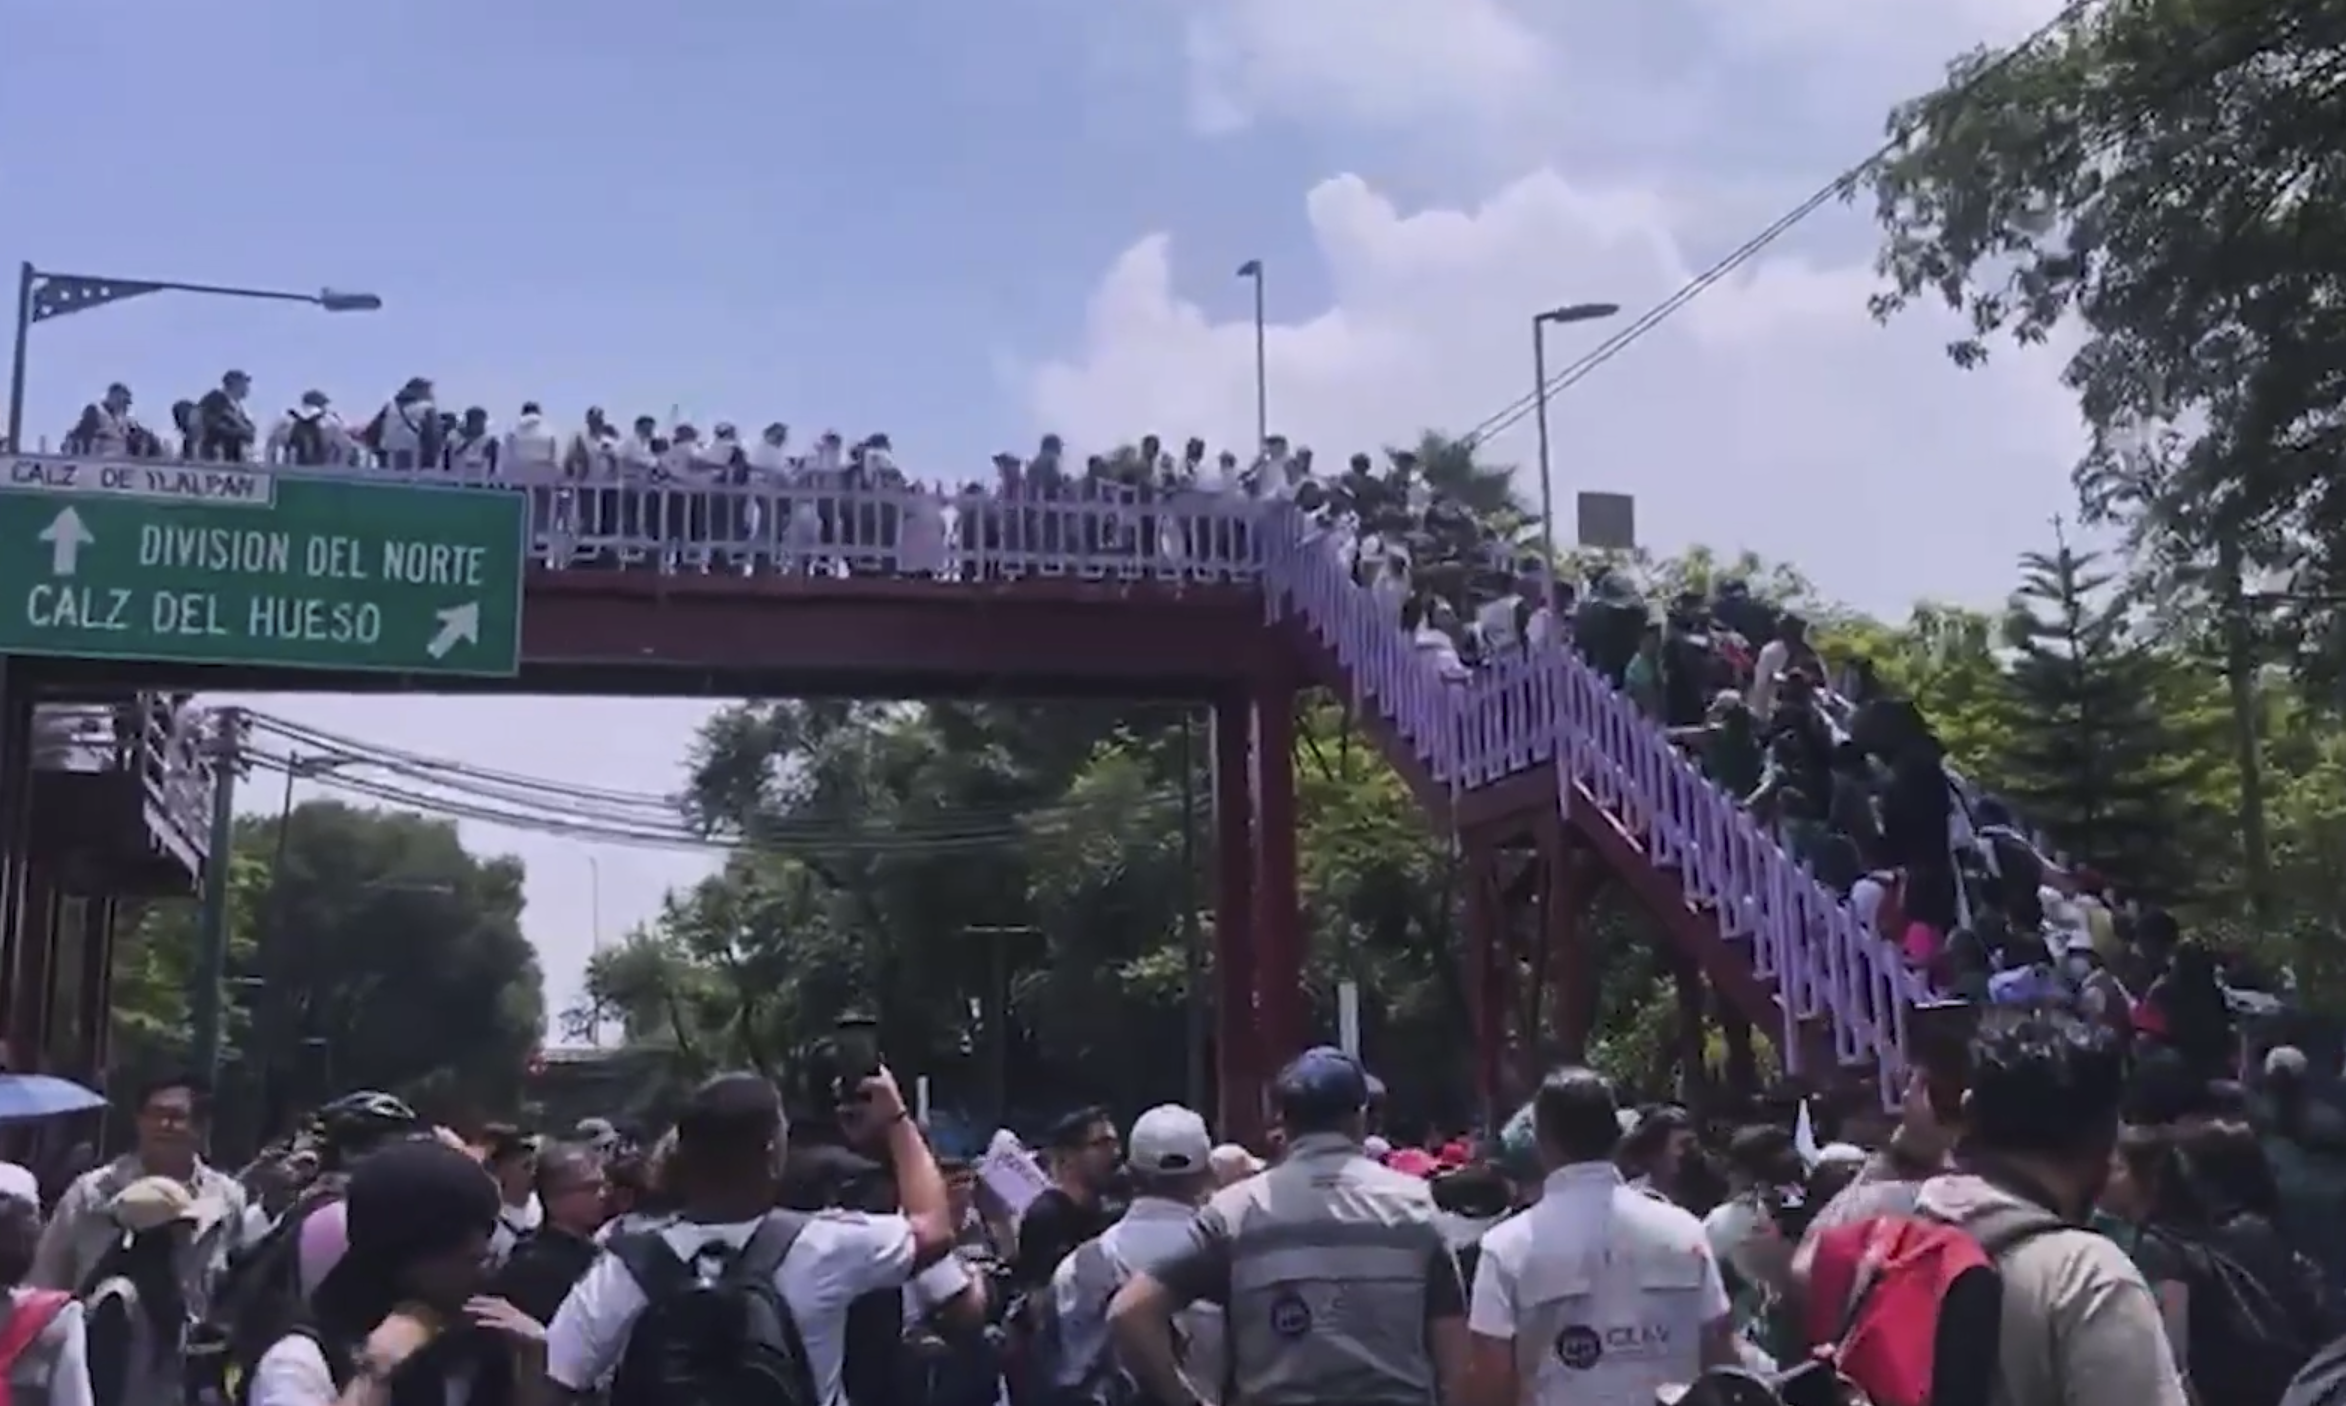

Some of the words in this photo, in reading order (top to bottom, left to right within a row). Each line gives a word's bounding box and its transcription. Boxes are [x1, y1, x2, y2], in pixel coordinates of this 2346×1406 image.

[11, 460, 77, 487] CALZ
[101, 467, 132, 489] DE
[139, 524, 289, 574] DIVISION
[306, 534, 368, 579] DEL
[383, 539, 487, 586] NORTE
[26, 584, 132, 629] CALZ
[152, 590, 228, 635] DEL
[249, 596, 381, 643] HUESO
